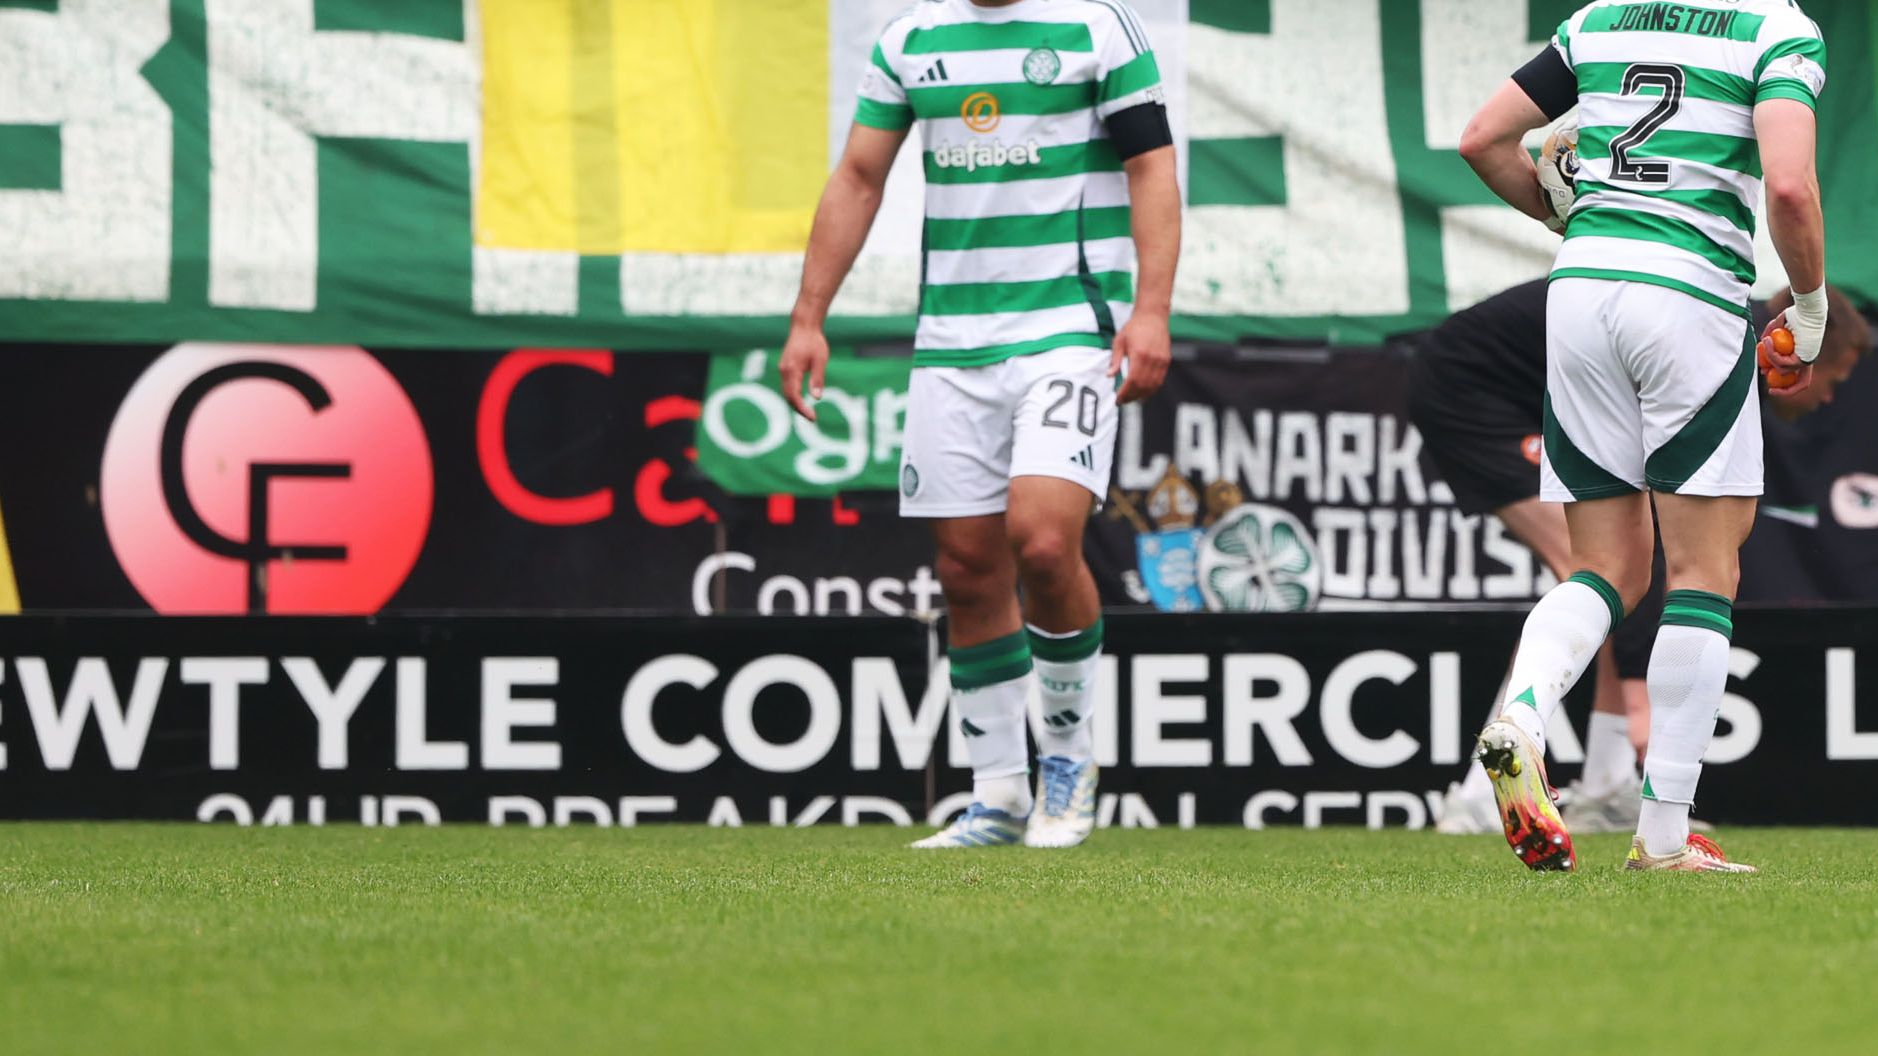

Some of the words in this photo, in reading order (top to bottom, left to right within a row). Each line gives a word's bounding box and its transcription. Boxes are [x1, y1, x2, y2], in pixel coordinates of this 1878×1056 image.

[1609, 3, 1732, 37] JOHNSTON
[934, 136, 1041, 172] dafabet
[1608, 63, 1685, 185] 2
[1041, 379, 1099, 437] 20
[1118, 401, 1456, 506] LANARK
[1312, 506, 1562, 600] DIVIS
[0, 657, 562, 770] WTYLE
